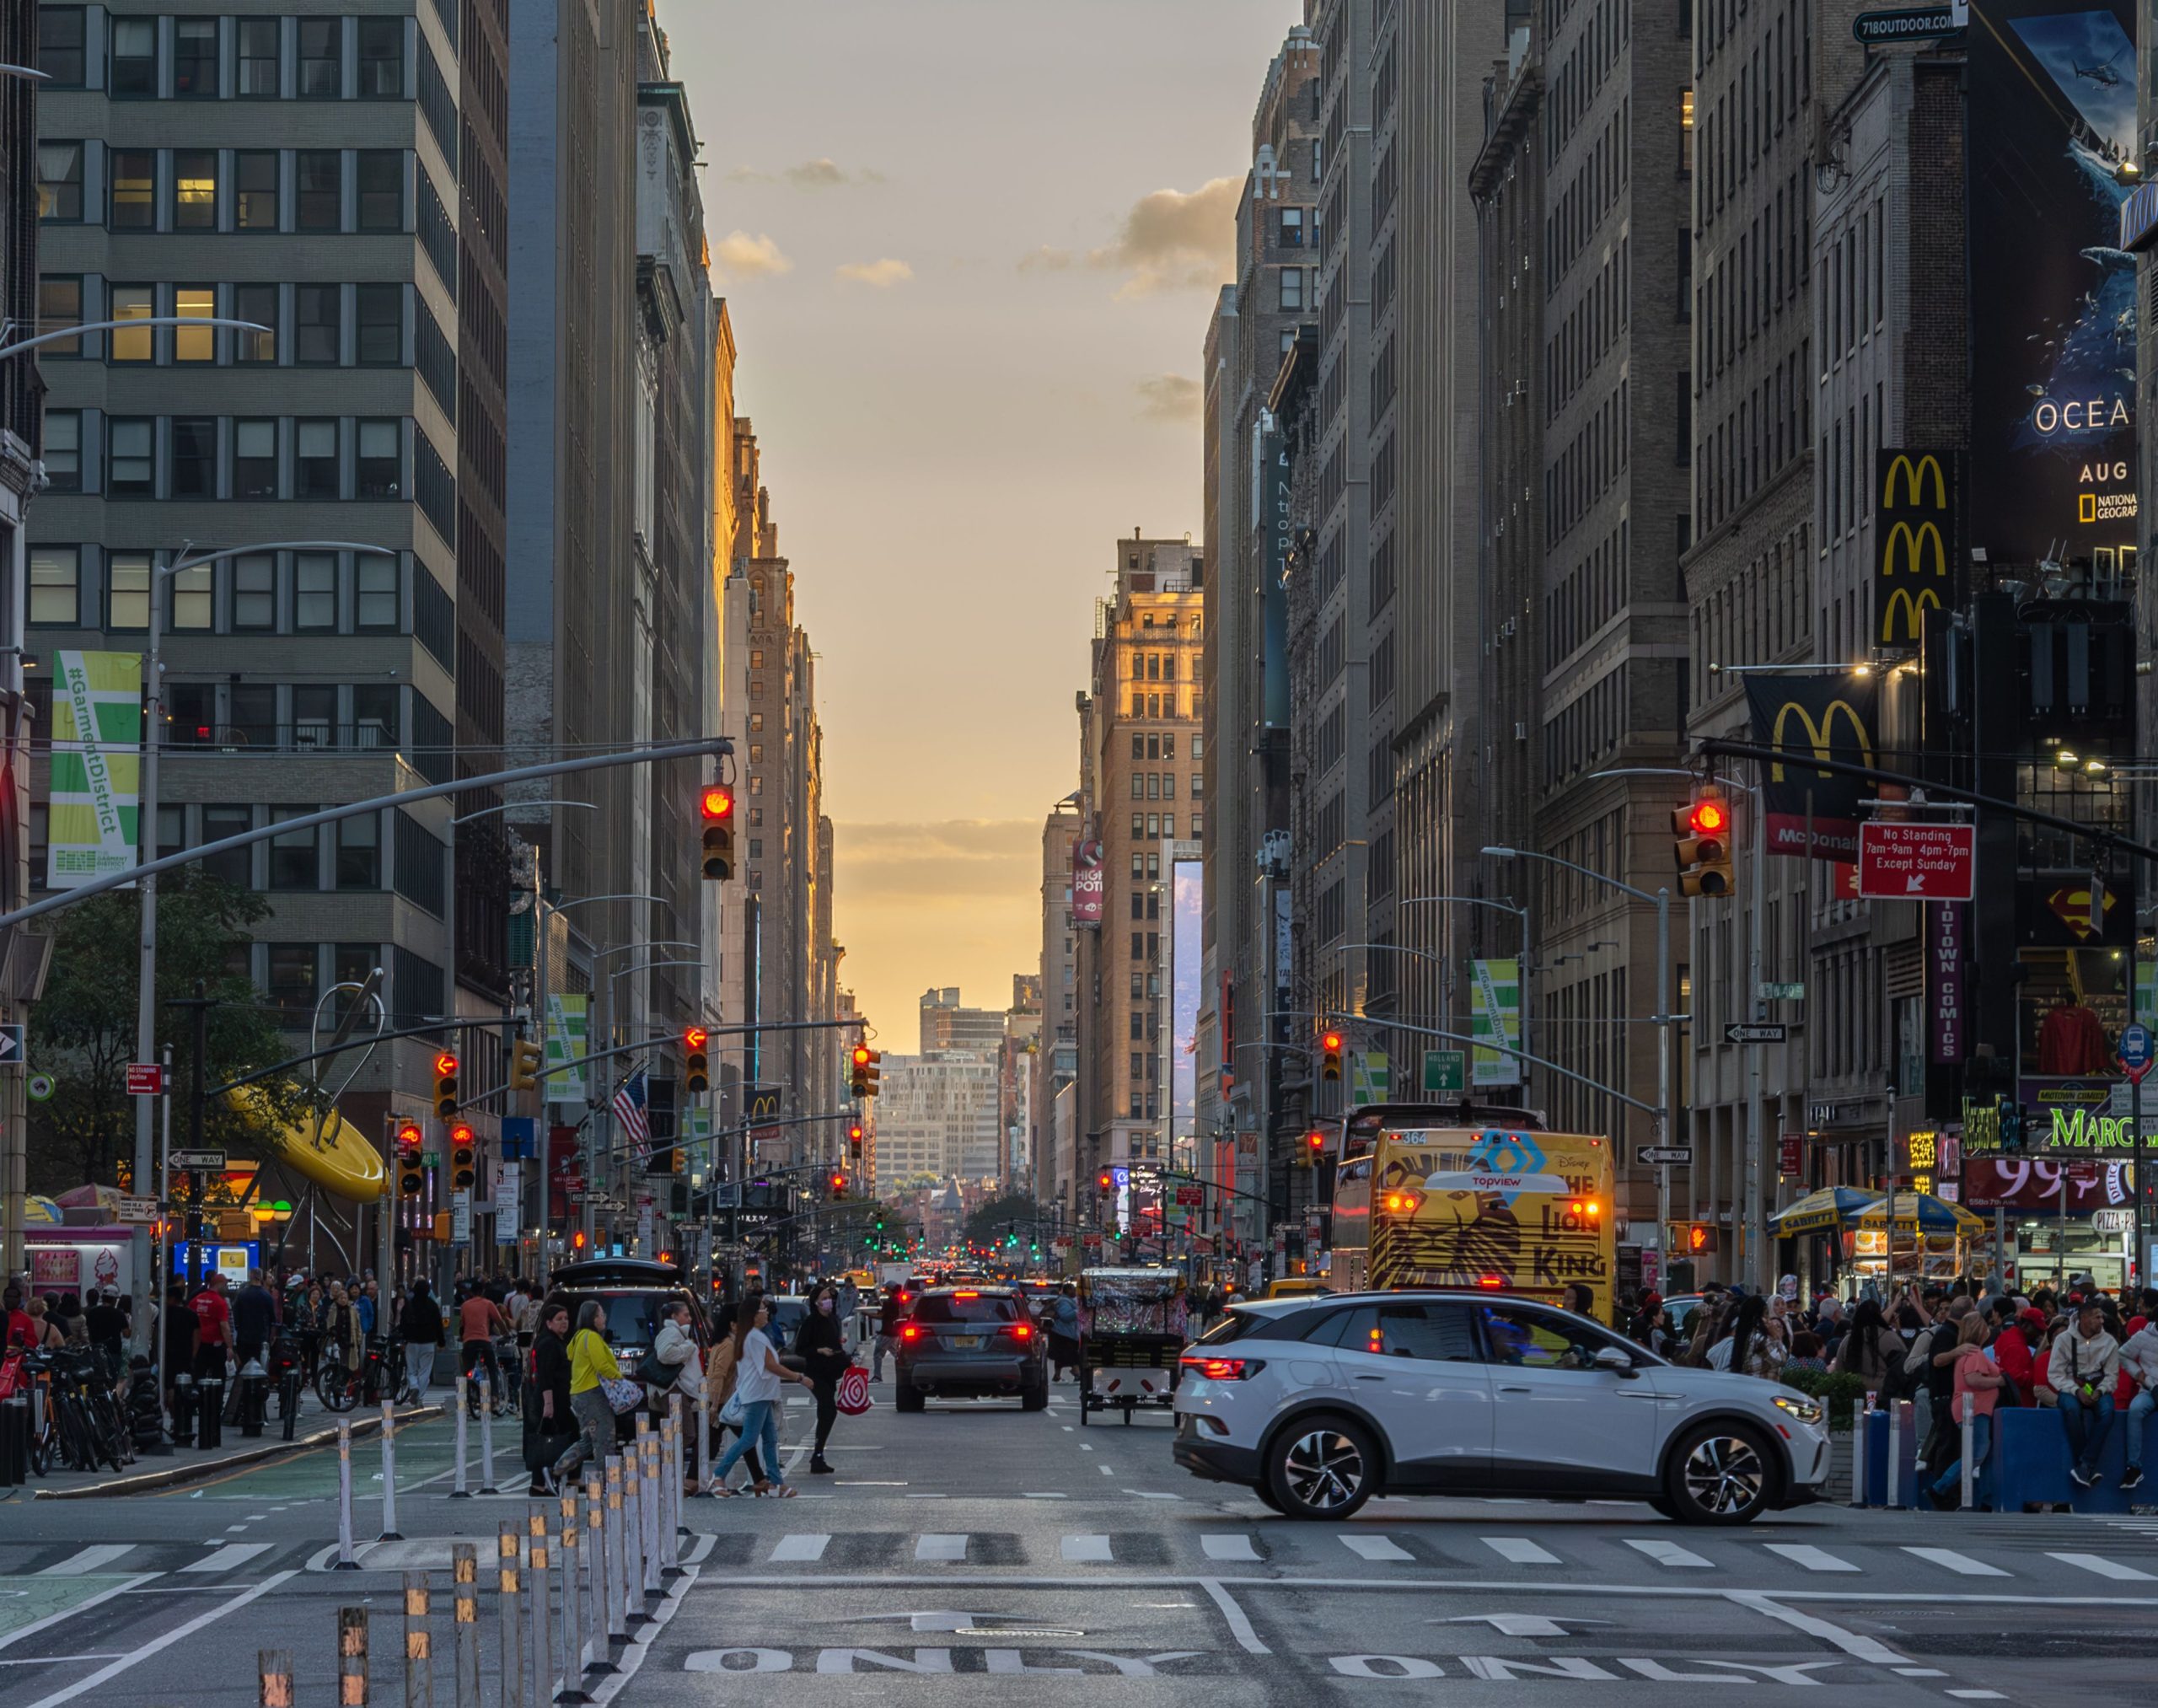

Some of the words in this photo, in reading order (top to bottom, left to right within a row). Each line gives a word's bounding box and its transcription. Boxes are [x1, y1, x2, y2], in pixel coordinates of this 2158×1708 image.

[2079, 462, 2128, 483] AUG
[68, 666, 117, 835] #GarmentDistrict
[1883, 829, 1898, 841] No
[1903, 829, 1951, 844] Standing
[1866, 842, 1913, 855] 7am-9am
[1919, 844, 1969, 858] 4pm-7pm
[1876, 857, 1913, 872] Except
[1917, 858, 1957, 873] Sunday
[1940, 982, 1957, 1056] COMICS
[1733, 1029, 1752, 1039] ONE
[1759, 1029, 1779, 1039] WAY
[1403, 1132, 1427, 1144] 364
[174, 1156, 191, 1164] ONE
[201, 1156, 220, 1164] WAY
[1645, 1149, 1661, 1160] ONE
[1671, 1149, 1686, 1160] WAY
[1554, 1155, 1592, 1171] Disney
[1542, 1204, 1601, 1241] LION
[1863, 1219, 1915, 1229] SABETT
[2097, 1211, 2120, 1230] PIZZA
[1533, 1245, 1606, 1286] KING
[684, 1646, 1217, 1677] ONLY
[1327, 1654, 1844, 1686] ONLY
